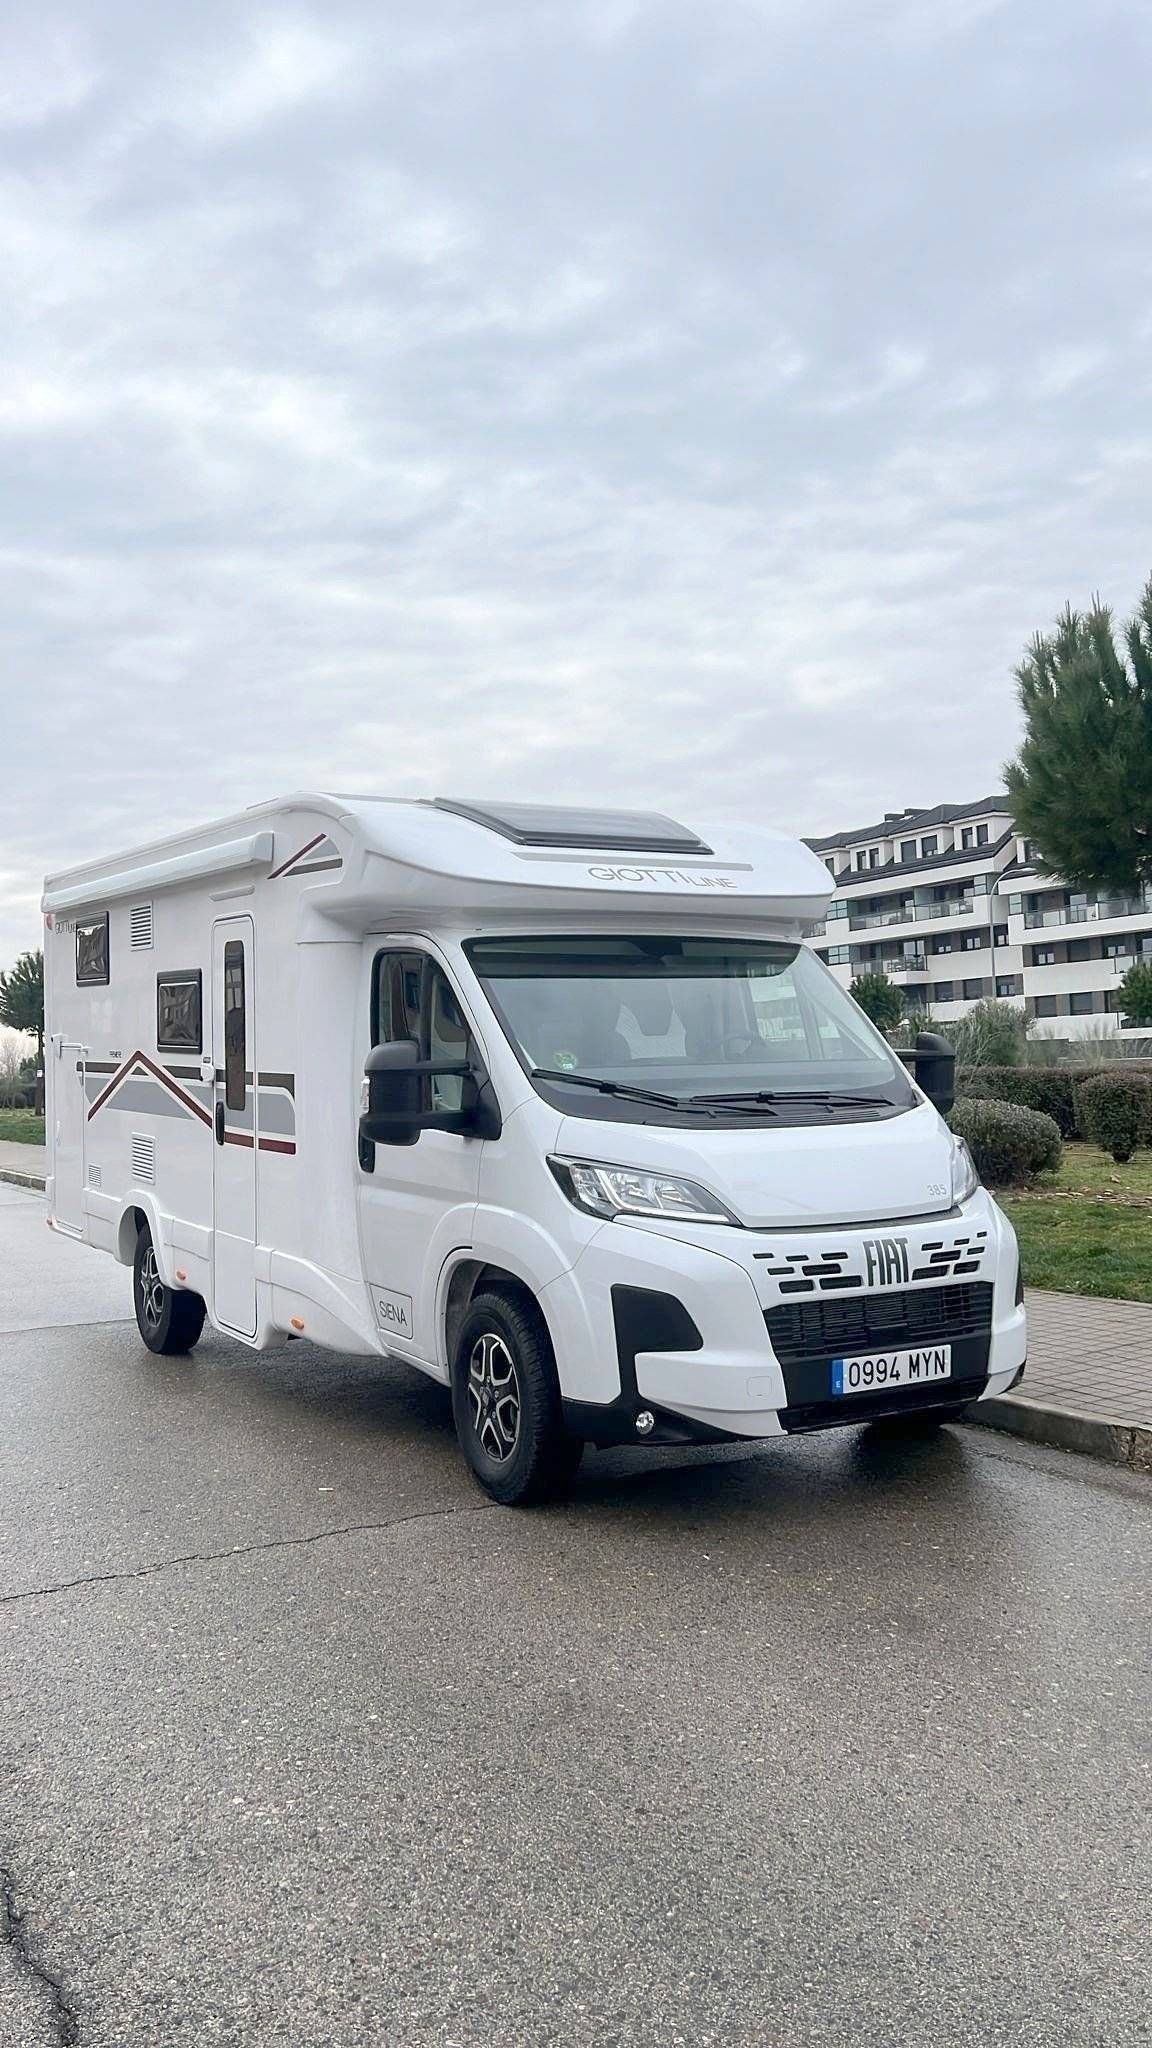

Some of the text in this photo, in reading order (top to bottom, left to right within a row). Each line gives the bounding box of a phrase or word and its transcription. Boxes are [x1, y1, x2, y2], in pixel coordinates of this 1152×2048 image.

[588, 867, 738, 888] GIOTTILINE
[927, 1184, 947, 1196] 385
[862, 1237, 909, 1287] FIAT
[379, 1300, 408, 1327] SIENA
[848, 1349, 945, 1387] 0994 MYN
